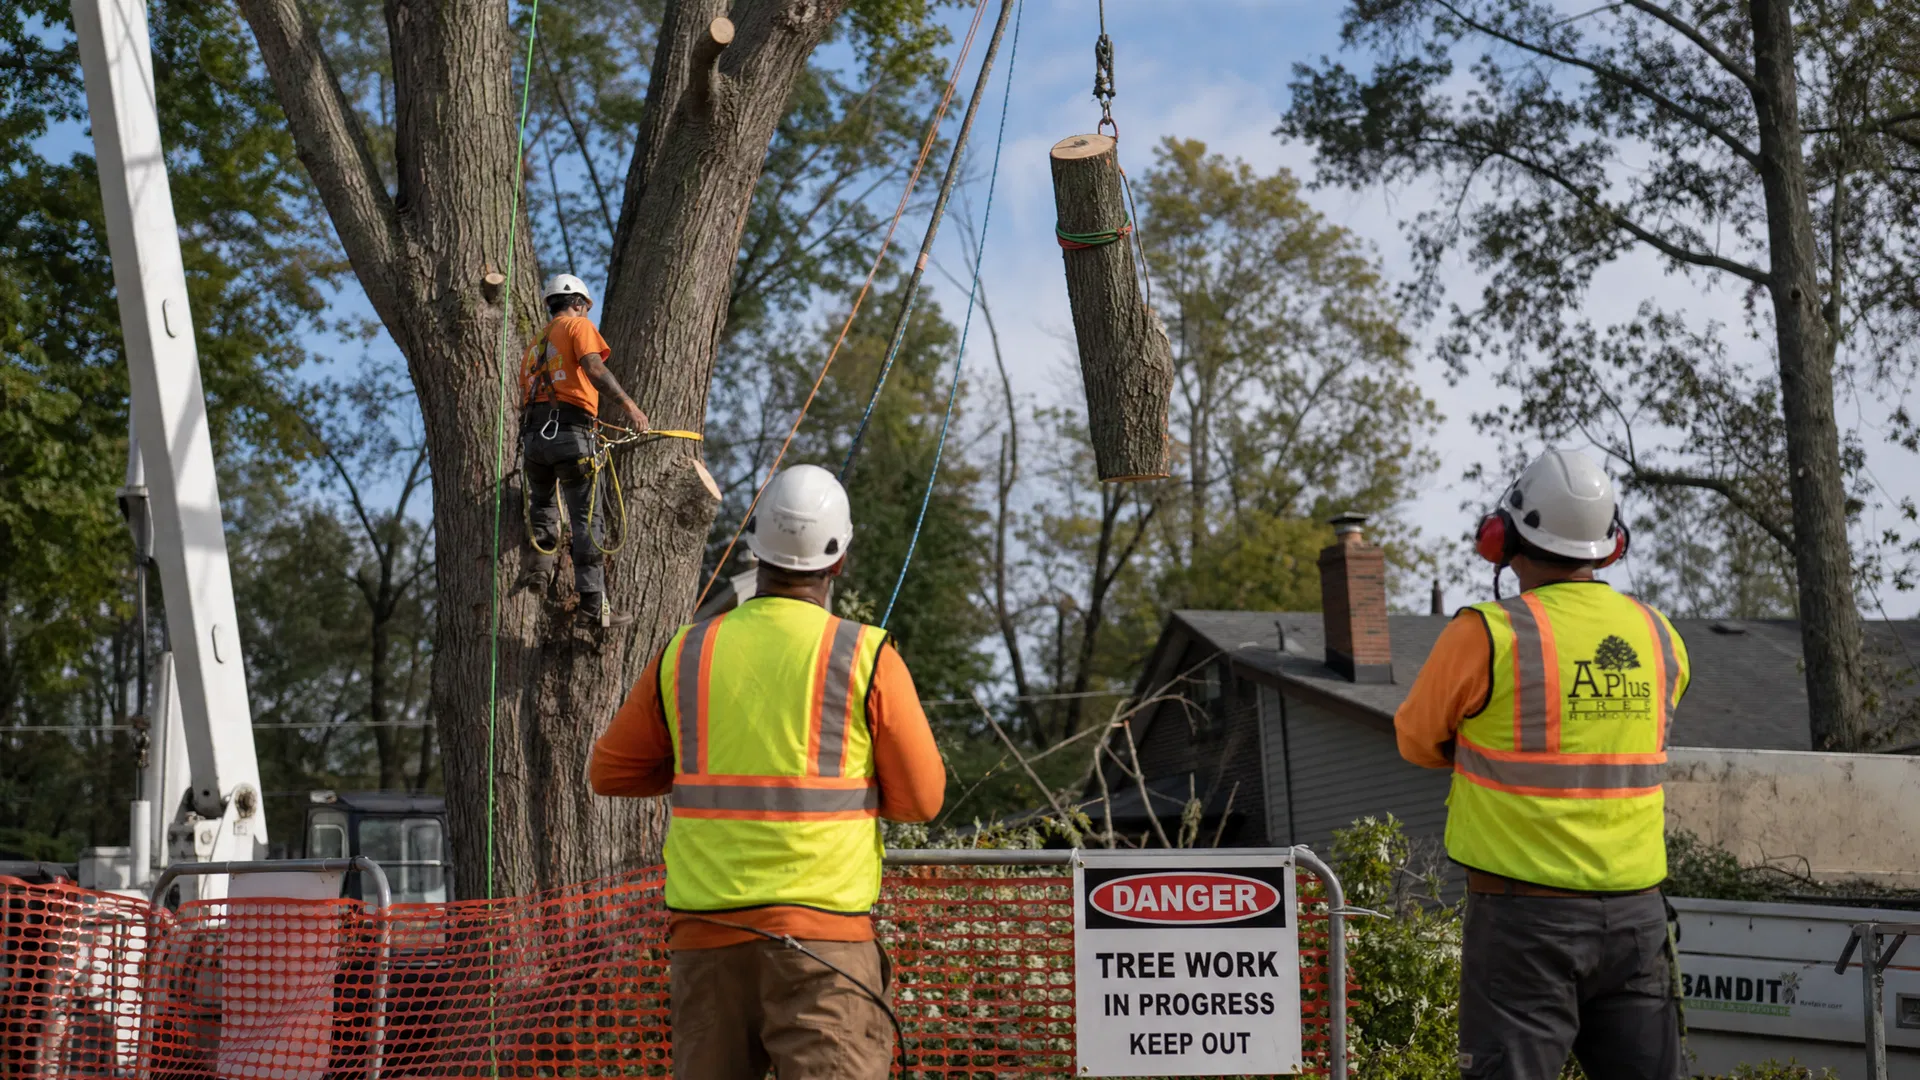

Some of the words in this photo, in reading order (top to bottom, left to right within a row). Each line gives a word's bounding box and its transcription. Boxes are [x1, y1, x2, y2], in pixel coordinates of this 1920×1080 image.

[1568, 660, 1603, 698] A
[1604, 673, 1651, 698] Plus
[1568, 700, 1651, 711] TREE
[1569, 712, 1650, 721] REMOVAL
[1112, 884, 1259, 912] DANGER
[1096, 952, 1176, 979] TREE
[1185, 951, 1279, 978] WORK
[1682, 973, 1782, 1004] BANDIT
[1104, 994, 1130, 1016] IN
[1139, 992, 1275, 1016] PROGRESS
[1130, 1033, 1193, 1055] KEEP
[1202, 1032, 1251, 1055] OUT
